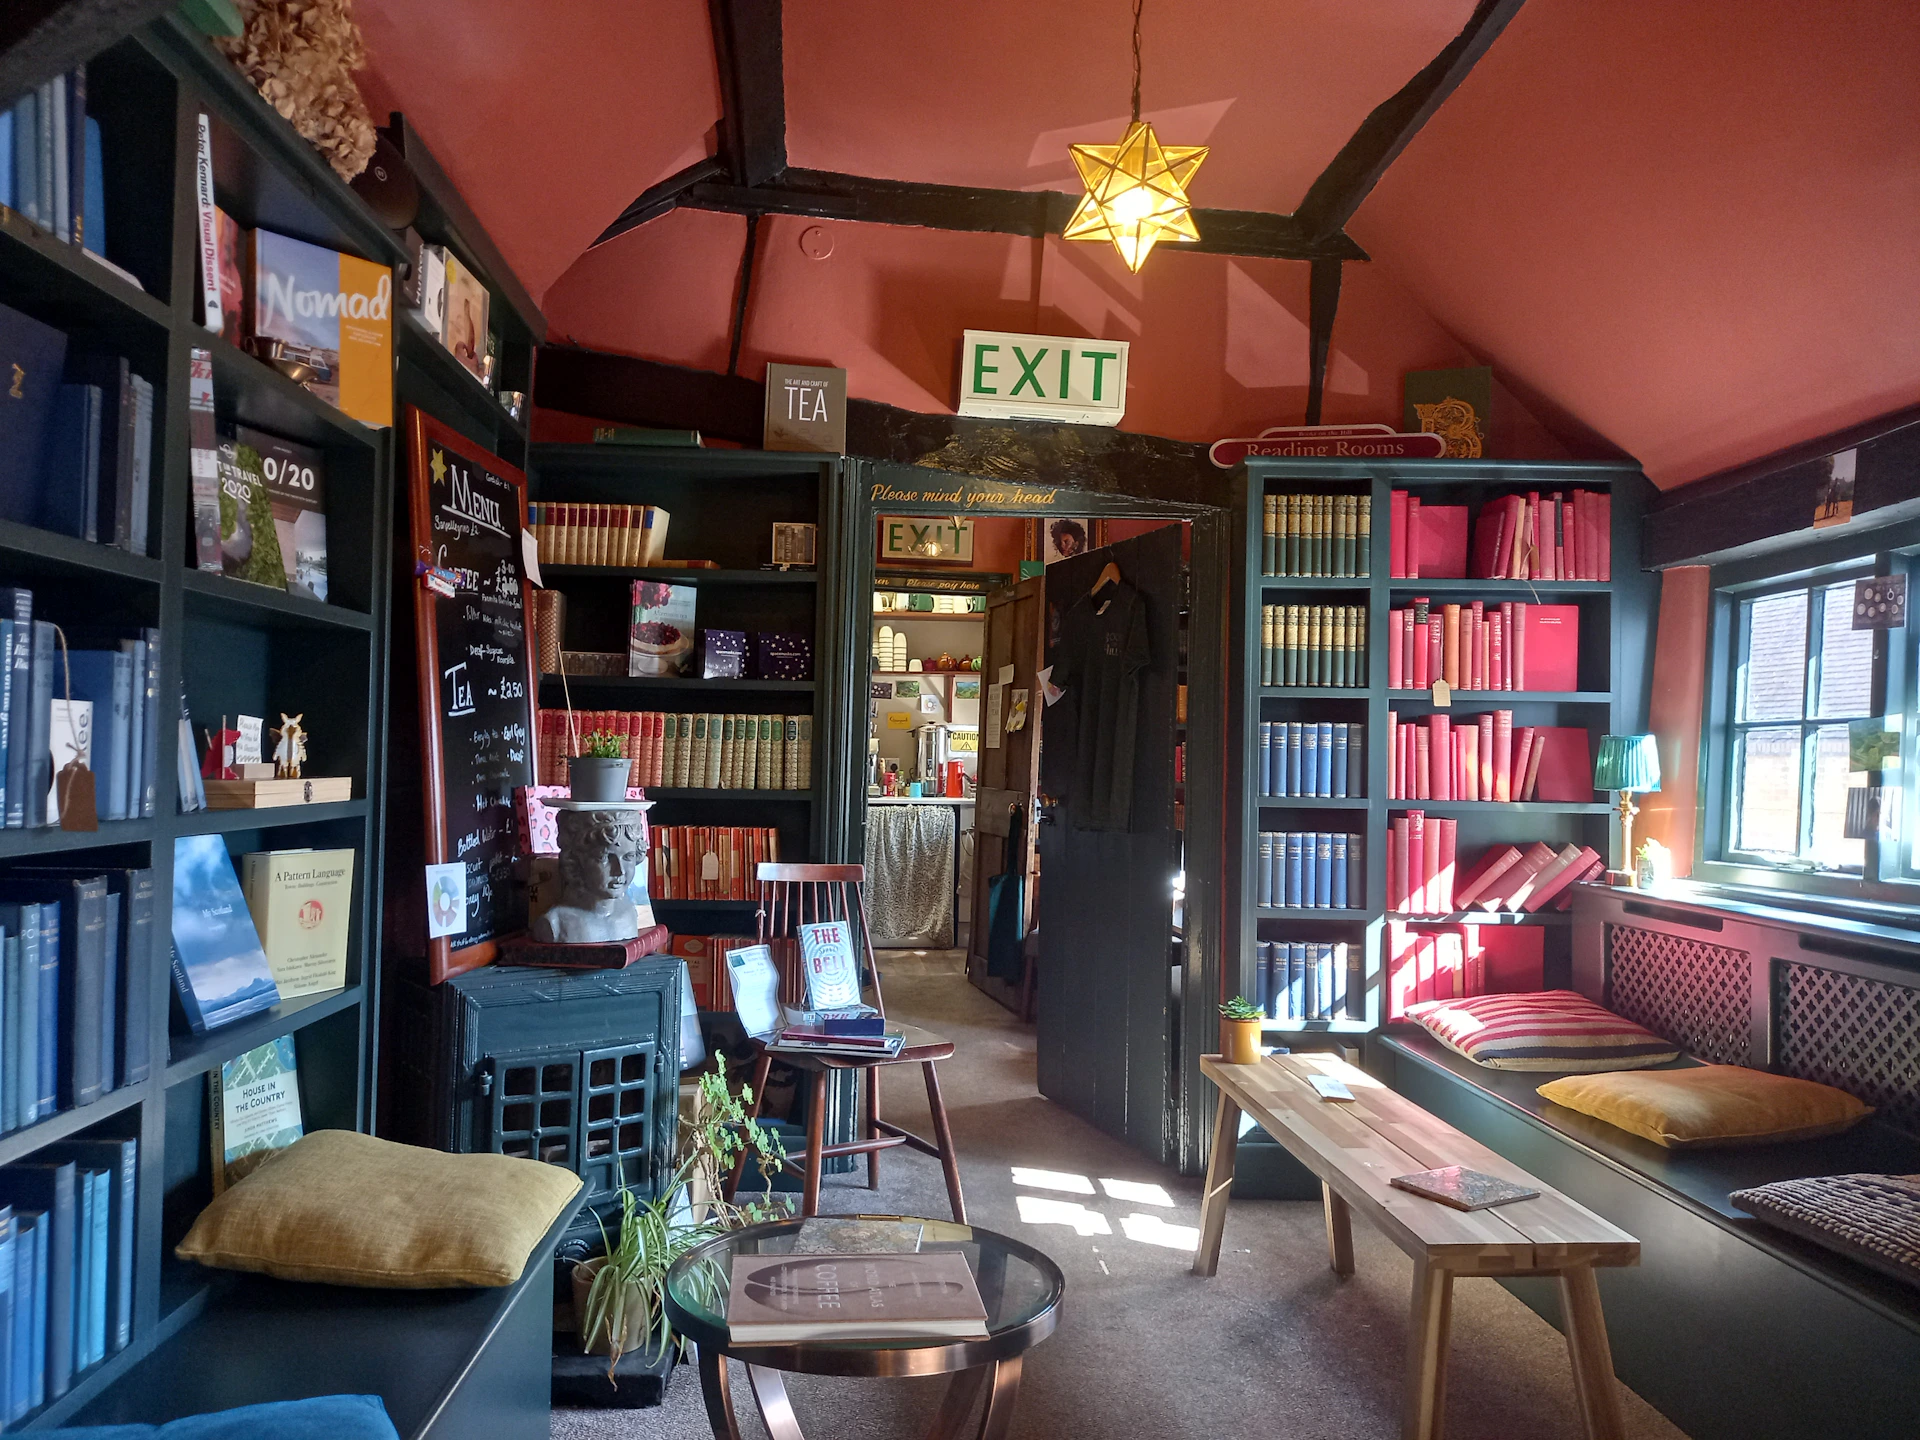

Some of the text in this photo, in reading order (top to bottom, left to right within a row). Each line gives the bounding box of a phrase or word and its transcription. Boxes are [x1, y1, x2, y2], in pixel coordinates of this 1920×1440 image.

[197, 123, 207, 156] Peter
[202, 211, 217, 292] Visual Dissent
[264, 273, 392, 329] Nomad
[972, 343, 1118, 402] EXIT
[784, 386, 829, 422] TEA
[1246, 440, 1405, 457] Reading Rooms
[231, 464, 263, 488] TRAVEL
[221, 476, 252, 504] 2020
[871, 483, 1058, 509] Please mind your head
[888, 523, 969, 555] EXIT
[906, 578, 936, 587] Please
[938, 582, 958, 591] pay
[457, 829, 481, 858] Bottled
[275, 867, 346, 882] A Pattern Language
[211, 904, 234, 916] Scotland
[465, 891, 481, 918] oney
[812, 927, 841, 945] THE
[171, 959, 190, 993] Scotland
[813, 955, 849, 974] BELL
[213, 1070, 219, 1078] IN
[235, 1102, 249, 1114] THE
[250, 1090, 286, 1108] COUNTRY
[242, 1081, 276, 1099] HOUSE IN
[814, 1263, 842, 1310] COFFEE
[864, 1262, 885, 1309] WORLD ATLAS
